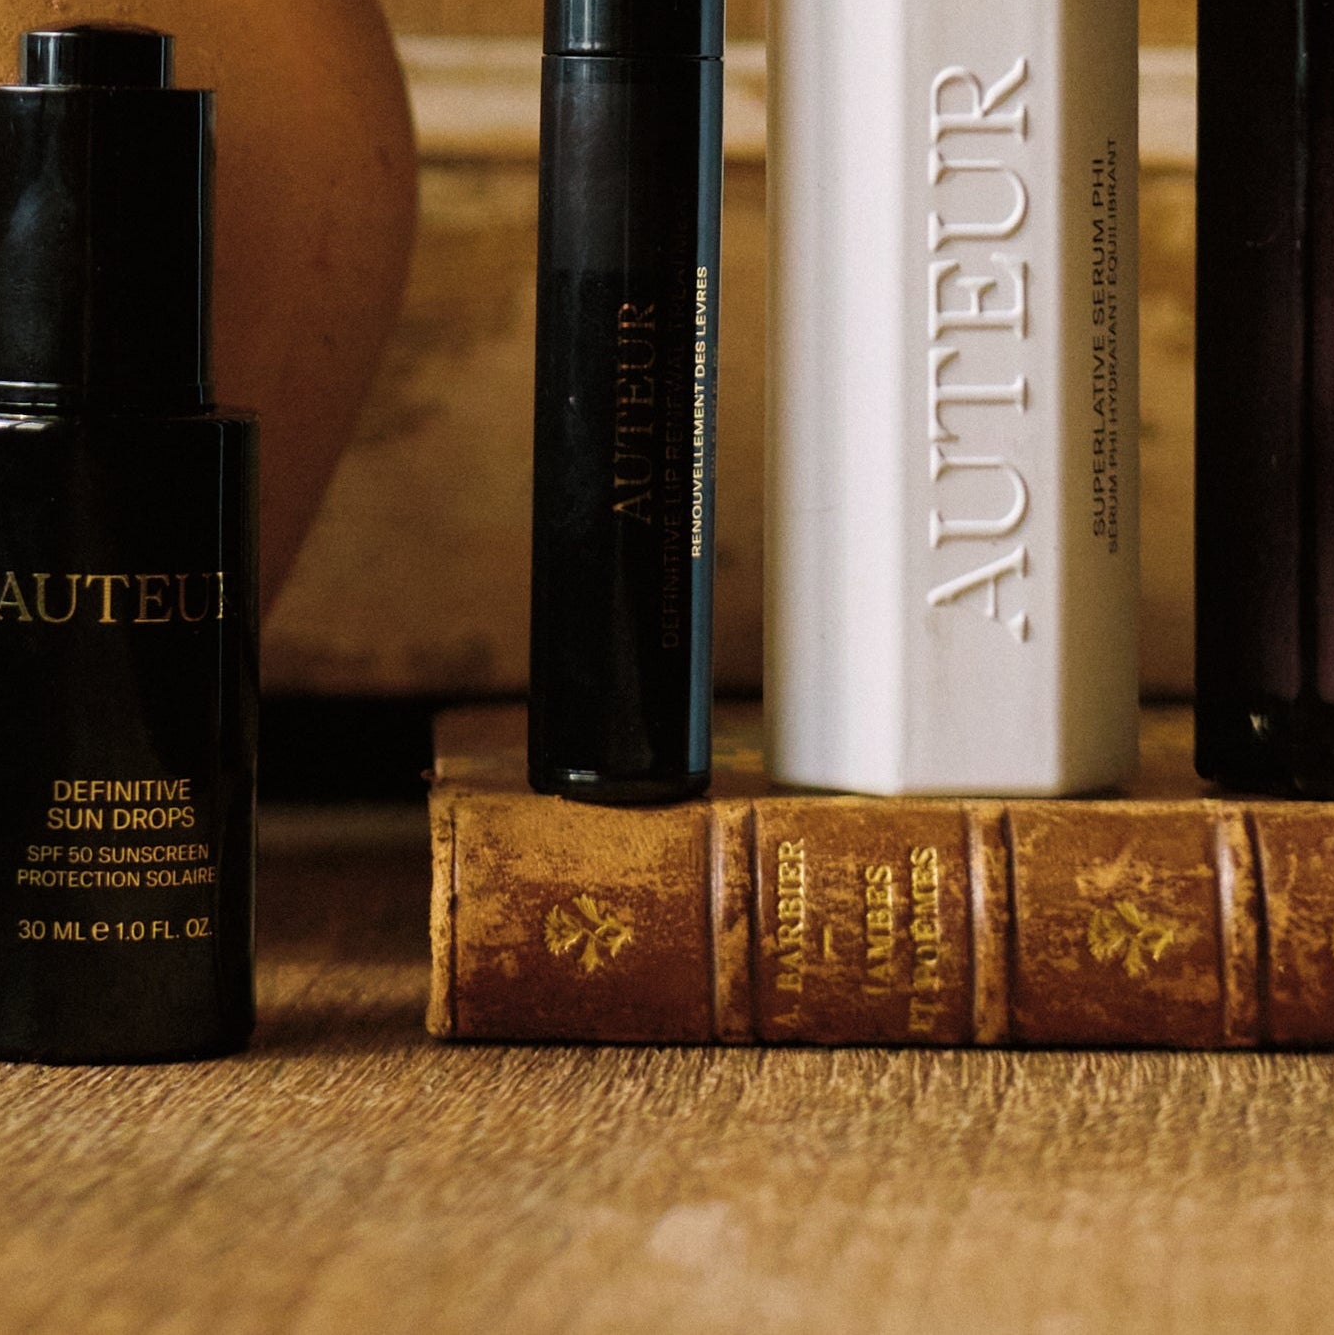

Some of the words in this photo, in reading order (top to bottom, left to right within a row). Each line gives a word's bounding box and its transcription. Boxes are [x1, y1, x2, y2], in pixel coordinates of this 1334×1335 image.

[1091, 158, 1104, 207] PHI
[1092, 218, 1105, 326] SERUM
[693, 340, 707, 379] DES
[925, 58, 1029, 644] AUTEUR
[611, 300, 656, 526] AUTEUR
[1092, 335, 1106, 537] SUPERLATIVE
[691, 381, 706, 559] RENOUVELLEMENT
[52, 778, 192, 803] DEFINITIVE
[46, 807, 104, 831] SUN
[112, 805, 196, 831] DROPS
[17, 868, 140, 888] PROTECTION
[146, 866, 216, 888] SOLAIRE
[27, 845, 64, 864] SPF
[68, 846, 94, 864] 50
[98, 843, 210, 864] SUNSCREEN
[17, 919, 46, 940] 30
[53, 921, 86, 941] ML
[115, 921, 146, 941] 1.0
[152, 920, 180, 939] FL.
[186, 917, 213, 938] OZ.
[776, 837, 805, 994] BARBIER
